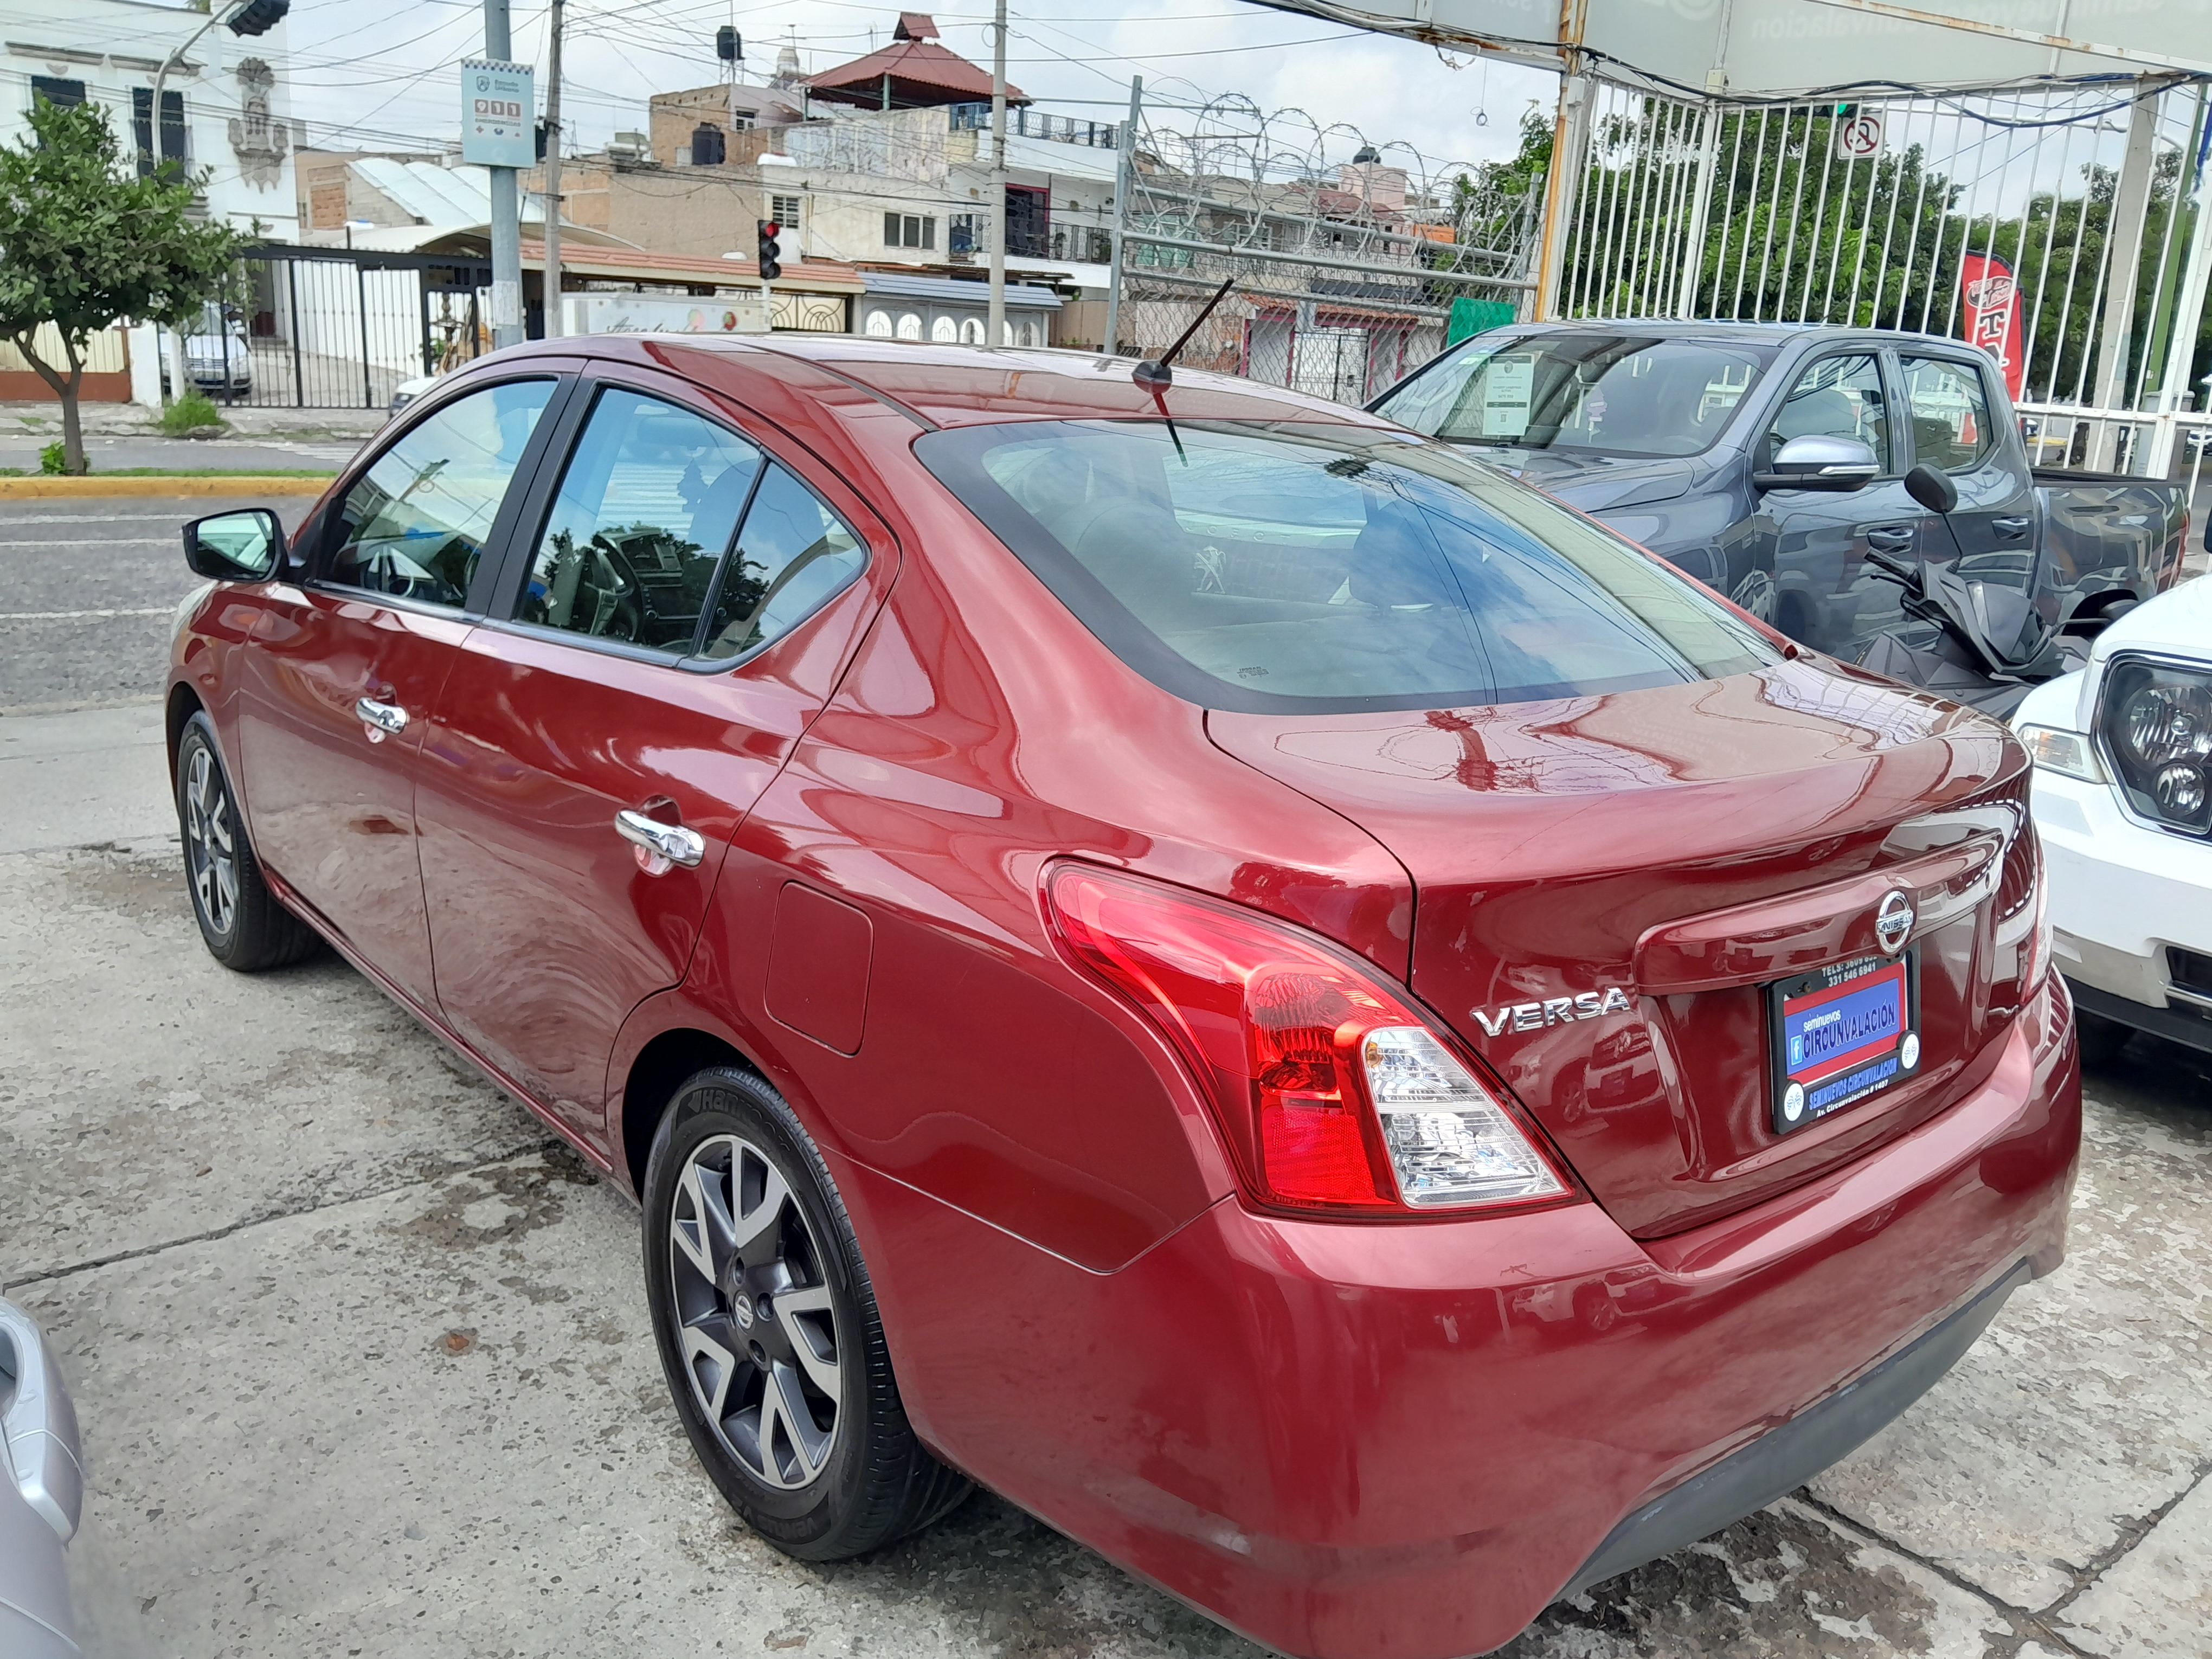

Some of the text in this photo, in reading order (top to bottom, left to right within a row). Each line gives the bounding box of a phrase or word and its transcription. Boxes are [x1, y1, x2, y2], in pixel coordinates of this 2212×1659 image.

[1828, 961, 1876, 987] 331 546 6941
[1471, 986, 1631, 1038] VERSA
[1803, 999, 1896, 1059] CIRCUNVALACIÓN
[1804, 1009, 1841, 1032] seminuevos
[1809, 1078, 1847, 1110] SEMINUEVOS
[1817, 1109, 1825, 1118] Av.
[1875, 1079, 1888, 1091] 1407
